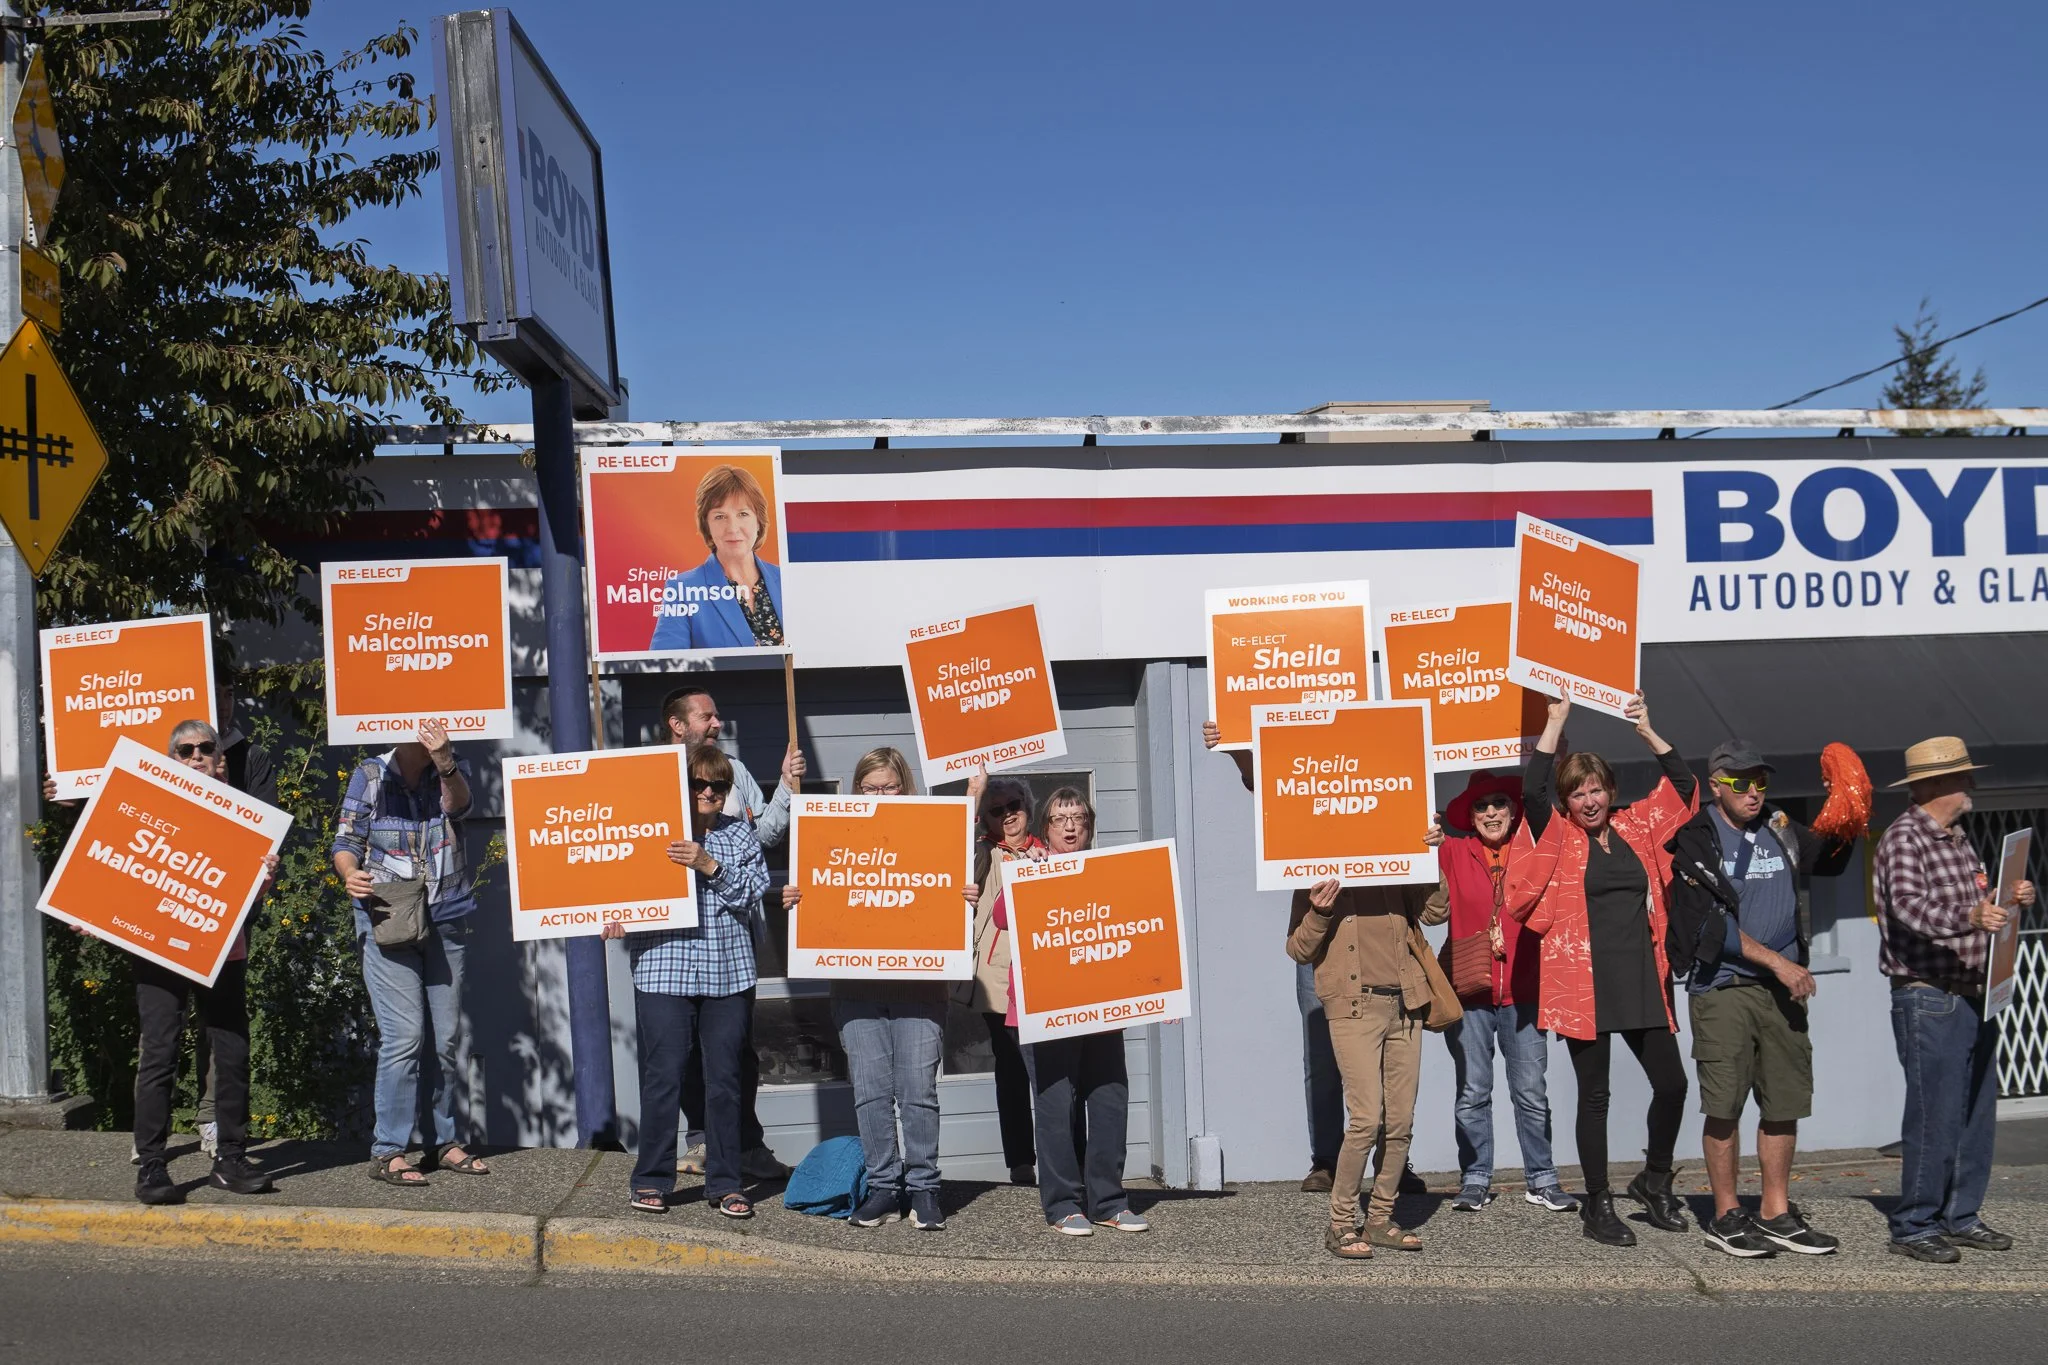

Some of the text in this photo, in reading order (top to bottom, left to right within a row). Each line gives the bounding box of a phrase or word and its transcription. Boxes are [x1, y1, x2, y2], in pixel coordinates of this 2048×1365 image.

[528, 126, 594, 272] BOYD
[536, 216, 572, 284] AUTOBODY
[598, 456, 668, 468] RE-ELECT
[1528, 523, 1574, 546] RE-ELECT
[338, 568, 402, 579] RE-ELECT
[628, 567, 678, 582] Sheila
[606, 582, 750, 604] Malcolmson
[1542, 572, 1590, 602] Sheila
[1689, 570, 1910, 612] AUTOBODY
[1934, 569, 1956, 604] &
[665, 604, 699, 616] NDP
[1228, 592, 1346, 607] WORKING FOR YOU
[1530, 586, 1628, 634] Malcolmson
[364, 612, 433, 631] Sheila
[1391, 608, 1450, 622] RE-ELECT
[56, 630, 114, 644] RE-ELECT
[910, 620, 960, 638] RE-ELECT
[1556, 616, 1602, 642] BC NDP
[348, 632, 488, 652] Malcolmson
[1232, 634, 1287, 646] RE-ELECT
[388, 652, 452, 671] BC NDP
[1254, 644, 1340, 670] Sheila
[1417, 648, 1480, 668] Sheila
[938, 657, 990, 681] Sheila
[1404, 666, 1510, 690] Malcolms
[80, 670, 142, 691] Sheila
[927, 666, 1036, 702] Malcolmson
[1226, 672, 1356, 692] Malcolmson
[1529, 668, 1622, 706] ACTION FOR YOU
[66, 687, 194, 712] Malcolmson
[962, 688, 1011, 710] BC NDP
[1315, 689, 1356, 702] NDP
[1442, 684, 1500, 704] BC NDP
[102, 707, 162, 726] BC NDP
[356, 719, 413, 732] ACTION
[454, 716, 486, 728] YOU
[1266, 710, 1330, 722] RE-ELECT
[946, 739, 1045, 772] ACTION FOR YOU
[1434, 742, 1534, 761] TION FOR YOU
[518, 760, 582, 774] RE-ELECT
[1292, 754, 1358, 775] Sheila
[74, 774, 100, 787] ACT
[1276, 775, 1412, 796] Malcolmson
[138, 759, 264, 824] WORKING FOR YOU
[545, 803, 613, 824] Sheila
[806, 802, 870, 812] RE-ELECT
[1316, 796, 1378, 814] BC NDP
[118, 802, 180, 836] RE-ELECT
[529, 822, 669, 846] Malcolmson
[128, 828, 226, 888] Sheila
[570, 842, 634, 863] BC NDP
[829, 848, 896, 866] Sheila
[87, 840, 228, 918] Malcolmson
[812, 868, 951, 887] Malcolmson
[1017, 860, 1078, 878] RE-ELECT
[1284, 860, 1410, 877] ACTION FOR YOU
[851, 890, 914, 907] BC NDP
[162, 900, 220, 933] BC NDP
[540, 906, 669, 926] ACTION FOR YOU
[1047, 902, 1110, 927] Sheila
[112, 916, 156, 942] bcndp.ca
[1032, 917, 1164, 950] Malcolmson
[816, 955, 944, 968] ACTION FOR YOU
[1072, 940, 1132, 963] BC NDP
[1045, 998, 1165, 1028] ACTION FOR YOU
